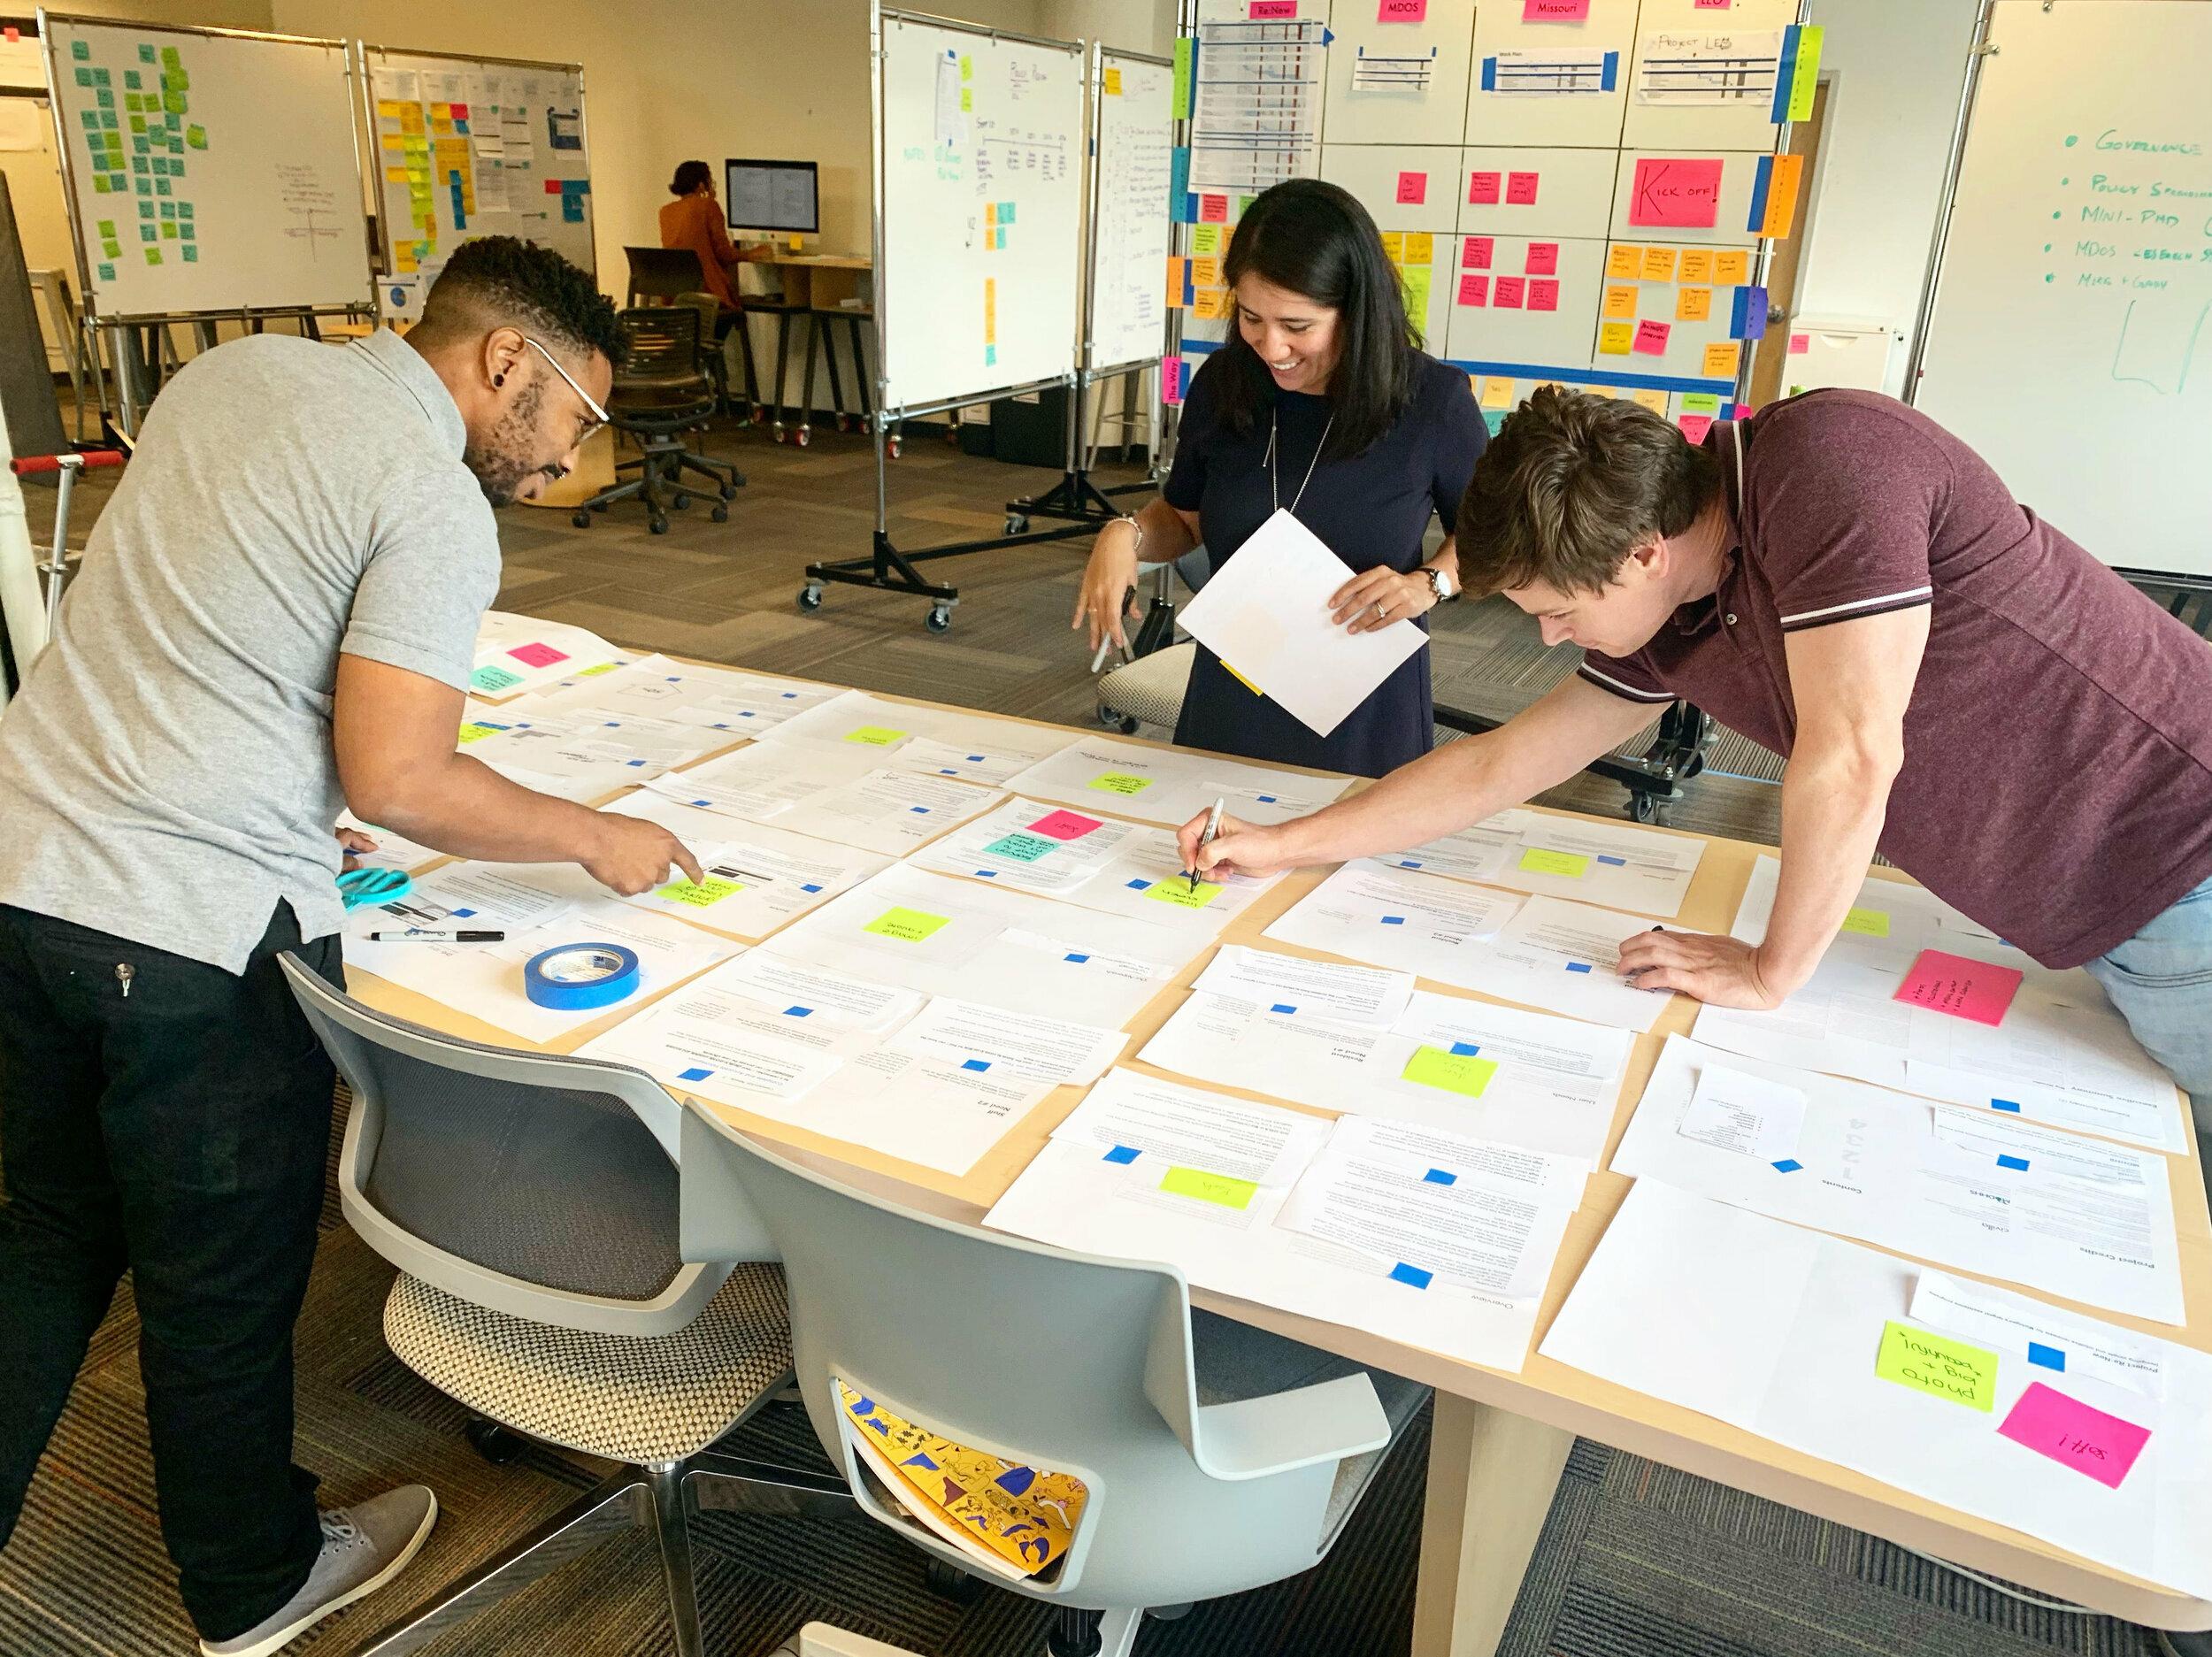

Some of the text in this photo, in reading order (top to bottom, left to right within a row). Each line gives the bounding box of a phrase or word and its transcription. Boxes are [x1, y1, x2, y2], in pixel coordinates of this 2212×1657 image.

[1388, 2, 1419, 13] MDOS
[1537, 2, 1578, 13] Missouri
[1170, 363, 1179, 383] Way
[1821, 1178, 1863, 1194] Contents
[2078, 1247, 2154, 1269] Project Credits
[1471, 1293, 1515, 1311] Overview
[1901, 1368, 1976, 1400] photo
[1946, 1363, 1977, 1386] big
